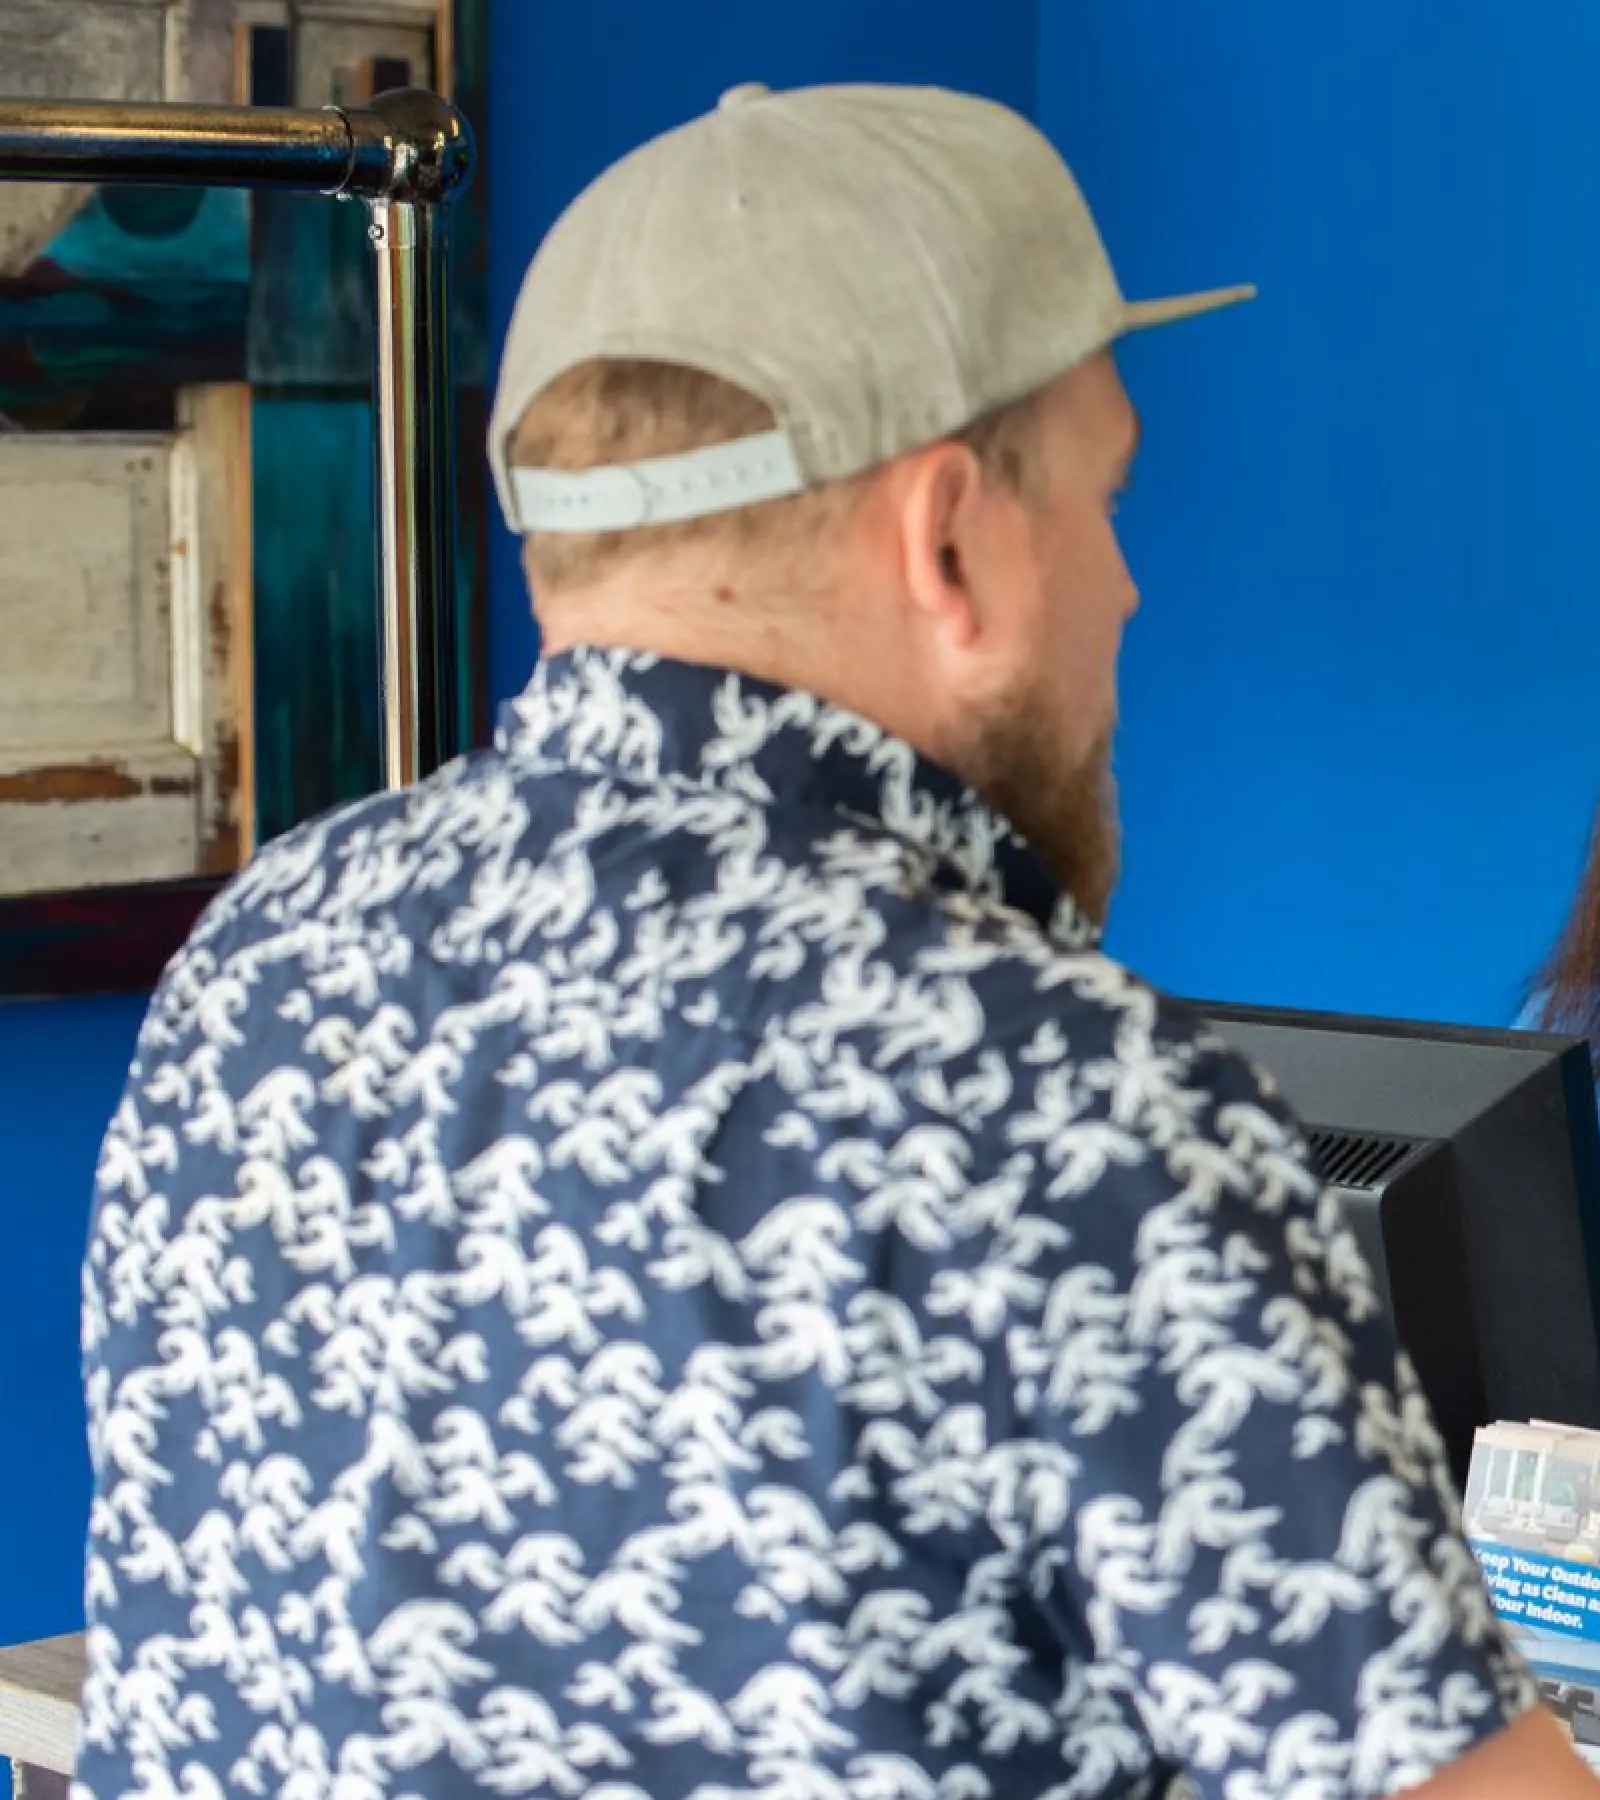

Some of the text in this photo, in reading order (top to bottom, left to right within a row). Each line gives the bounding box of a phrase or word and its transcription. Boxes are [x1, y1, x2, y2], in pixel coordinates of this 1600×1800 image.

[1512, 1556, 1549, 1579] Your
[1485, 1570, 1521, 1597] ving
[1522, 1583, 1540, 1597] as
[1542, 1585, 1587, 1609] Clean
[1526, 1601, 1583, 1629] Indoor.
